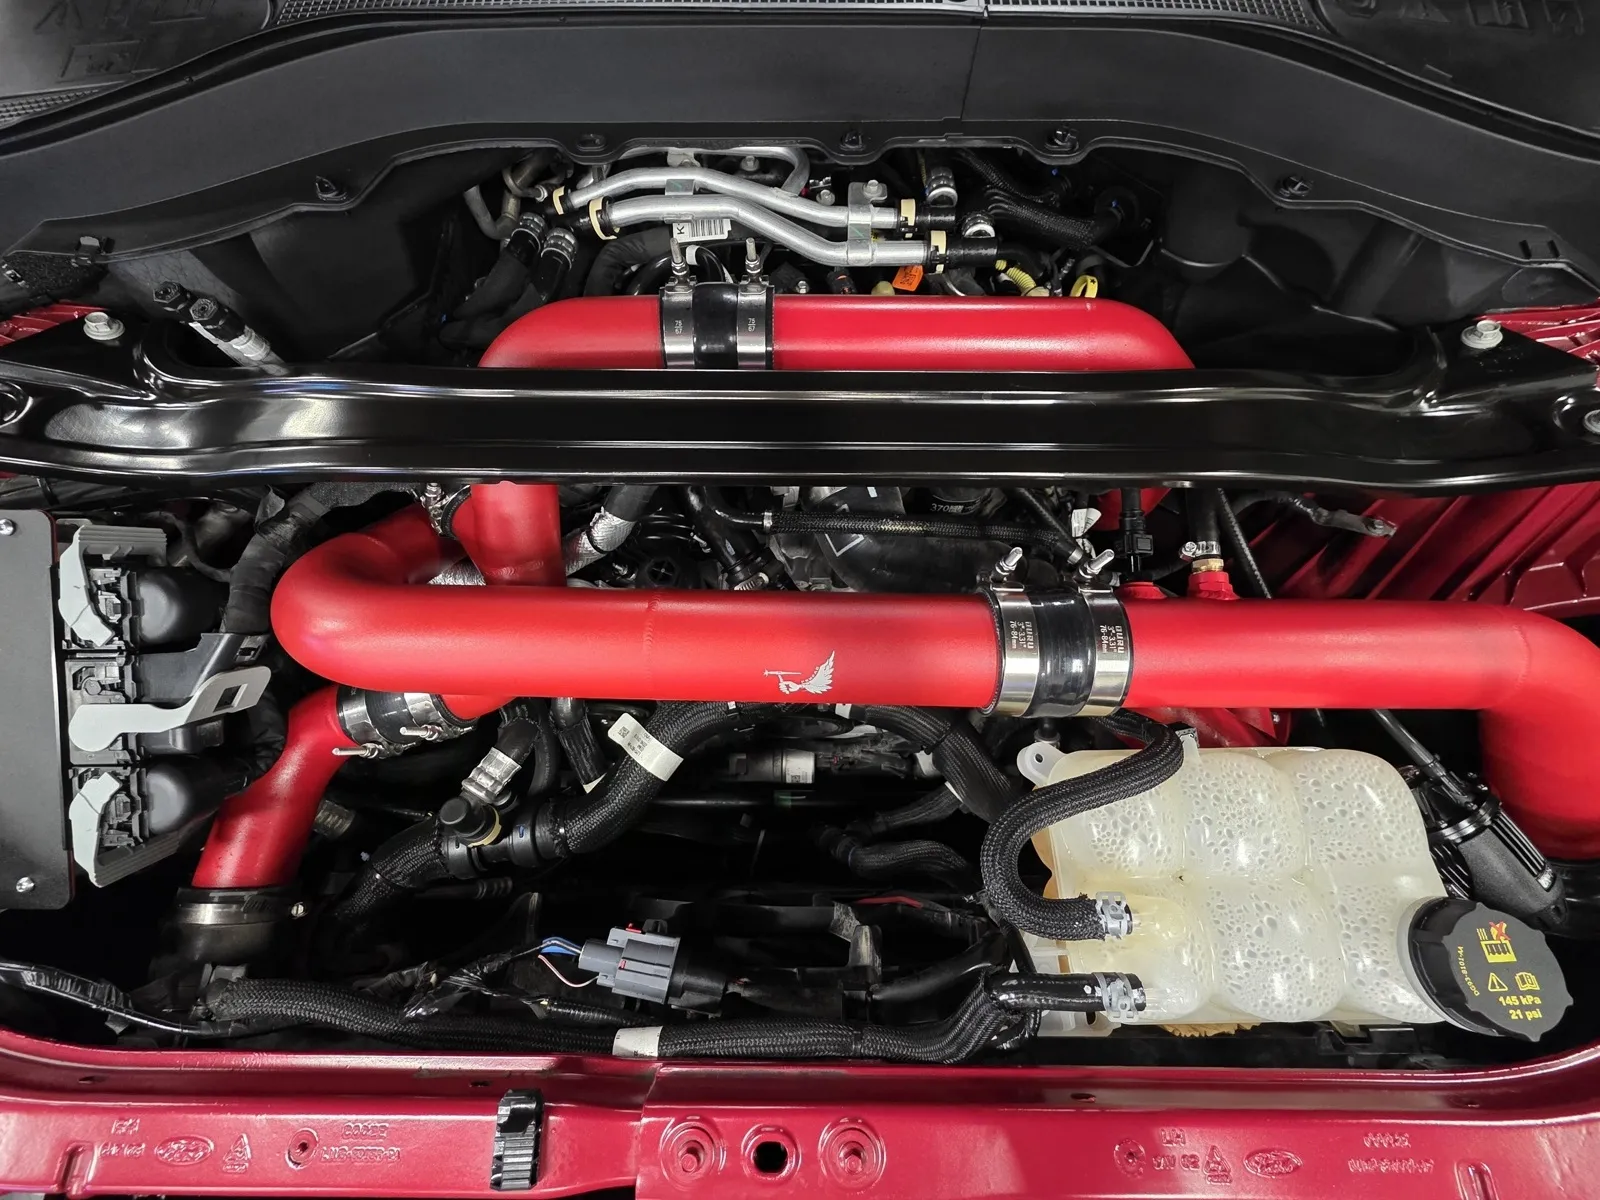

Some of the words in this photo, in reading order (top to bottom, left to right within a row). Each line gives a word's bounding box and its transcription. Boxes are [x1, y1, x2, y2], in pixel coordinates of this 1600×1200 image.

[1498, 995, 1519, 1006] 145
[1519, 994, 1542, 1005] kPa
[1509, 1009, 1523, 1020] 21
[1525, 1008, 1543, 1021] psi
